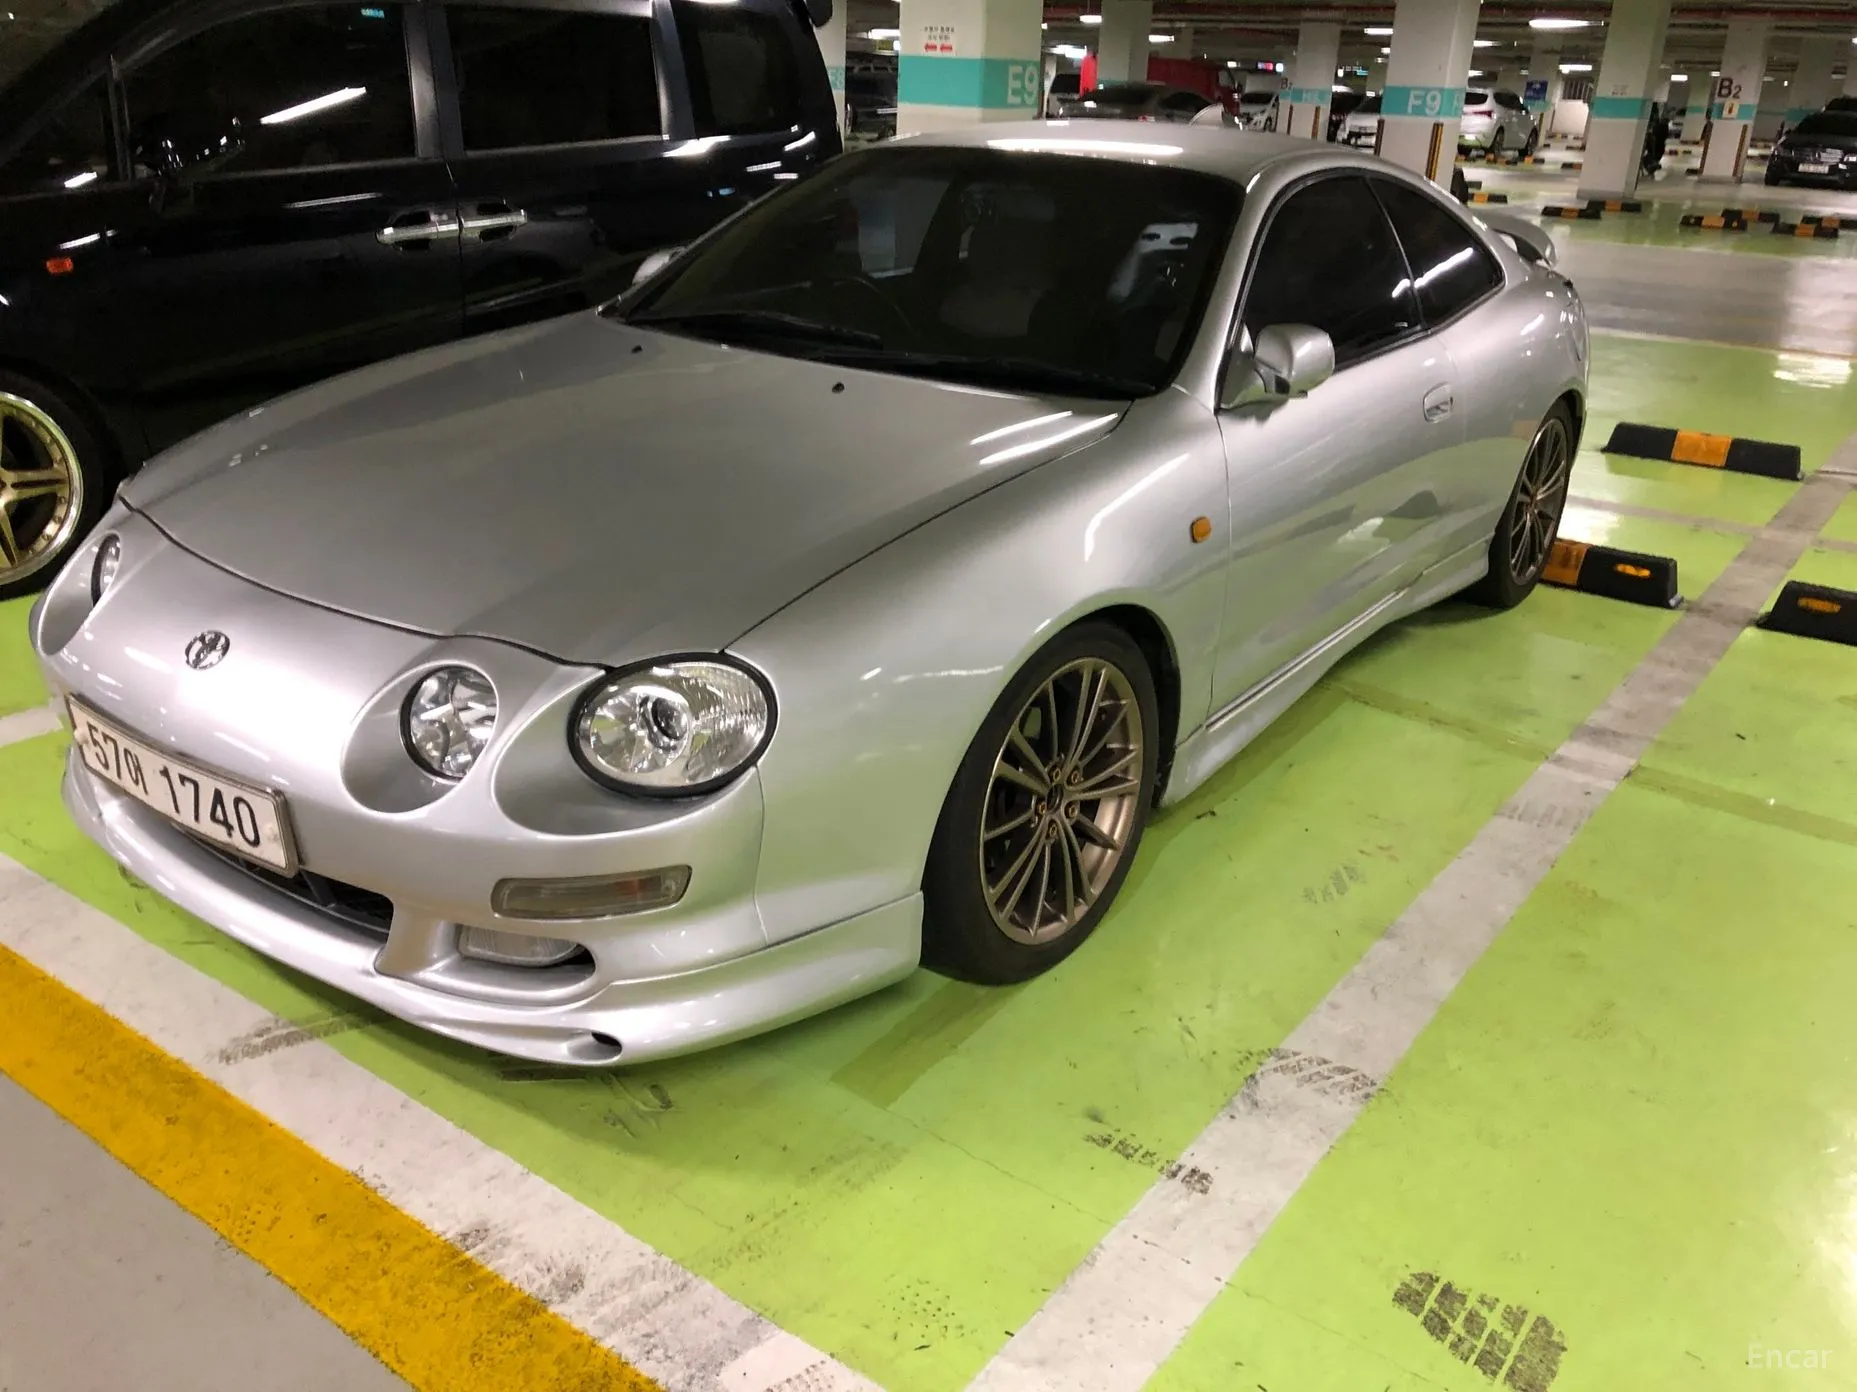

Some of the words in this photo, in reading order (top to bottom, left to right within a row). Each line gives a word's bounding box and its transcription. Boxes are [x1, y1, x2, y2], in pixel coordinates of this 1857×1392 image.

[1007, 63, 1039, 105] E9
[1717, 76, 1742, 99] B2
[1407, 88, 1442, 117] F9
[87, 720, 148, 795] 57어
[159, 765, 260, 847] 1740
